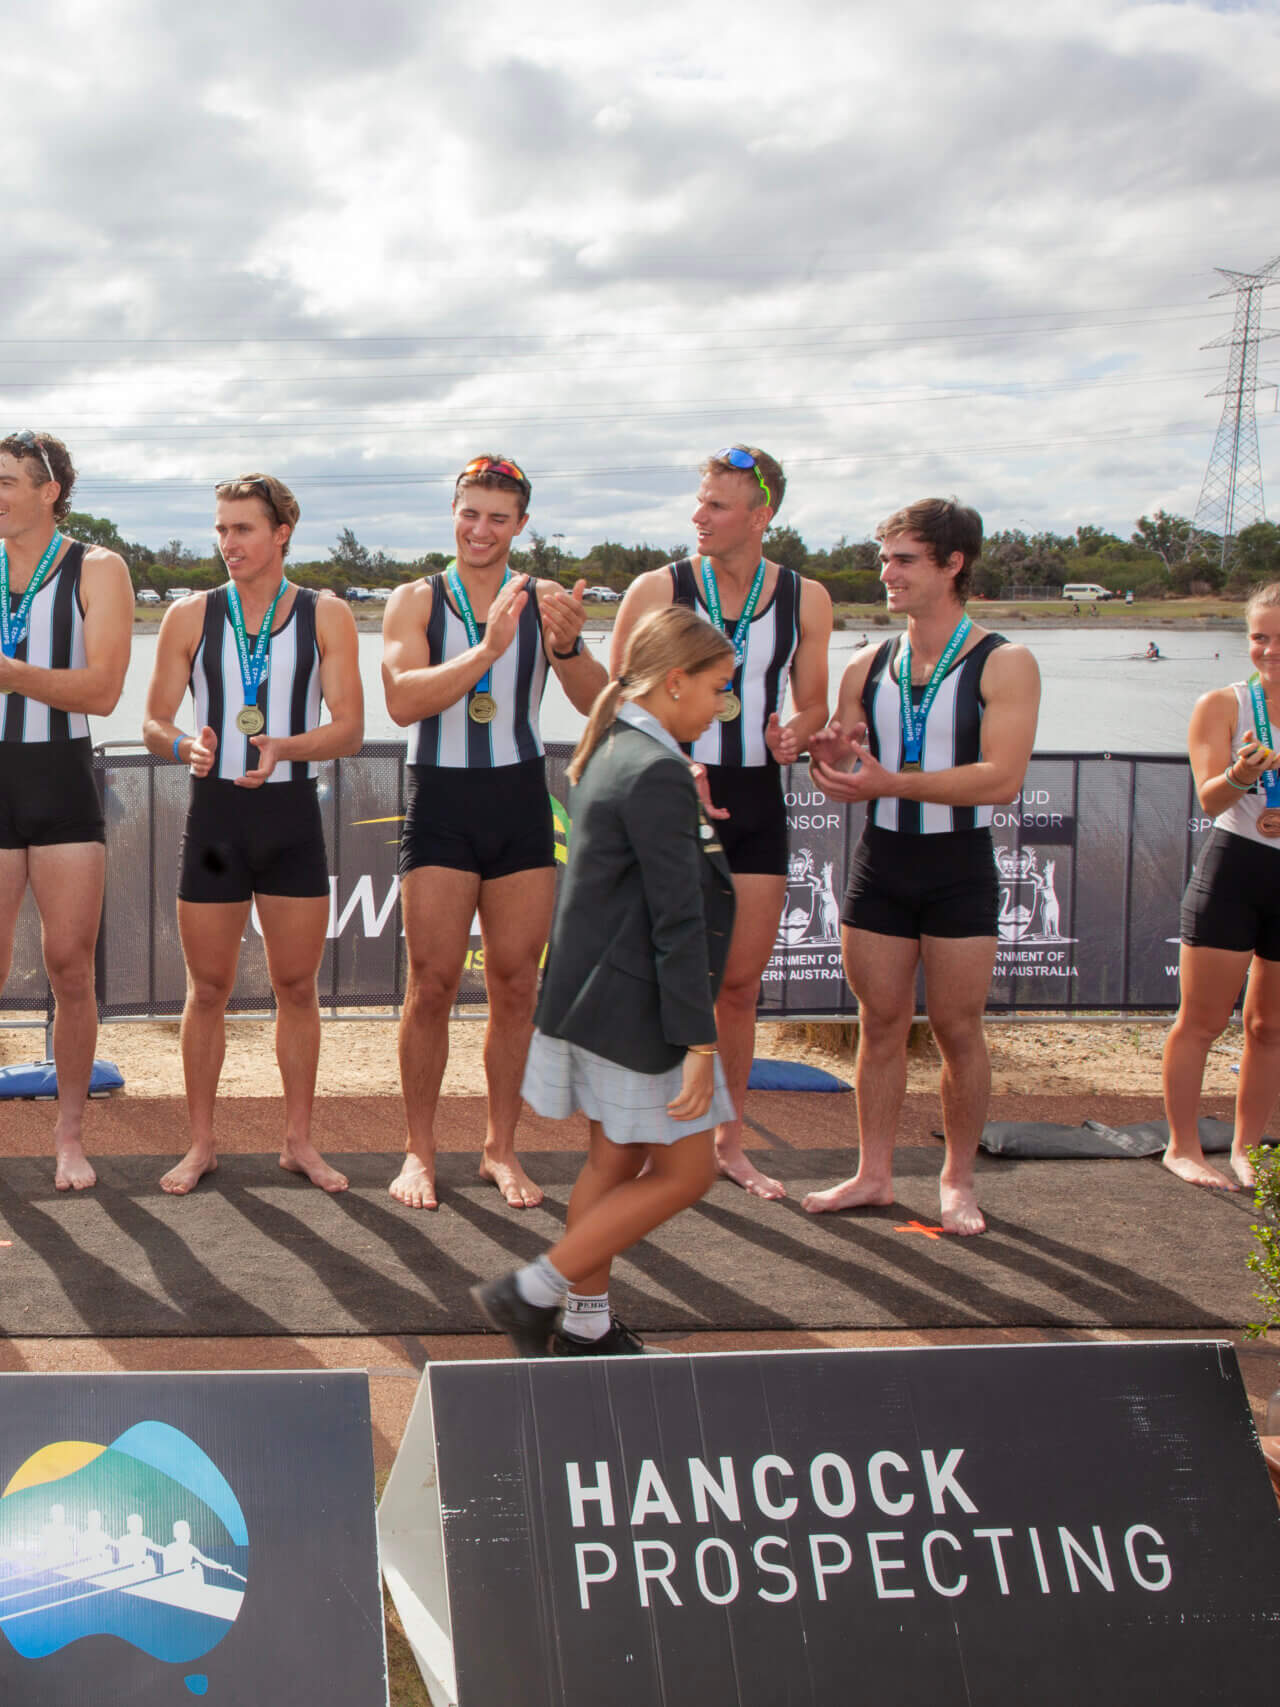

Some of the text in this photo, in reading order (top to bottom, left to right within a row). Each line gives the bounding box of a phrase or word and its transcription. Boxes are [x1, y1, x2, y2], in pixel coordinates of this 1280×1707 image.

[29, 559, 49, 592] WESTERN
[236, 626, 252, 685] CHAMPIONSHIPS
[932, 647, 955, 685] WESTERN
[784, 791, 826, 806] OUD
[786, 814, 840, 829] NSOR
[993, 813, 1063, 827] ONSOR
[996, 951, 1065, 961] RNMENT OF
[1009, 966, 1079, 976] AUSTRALIA
[565, 1449, 979, 1527] HANCOCK
[574, 1524, 1172, 1609] PROSPECTING
